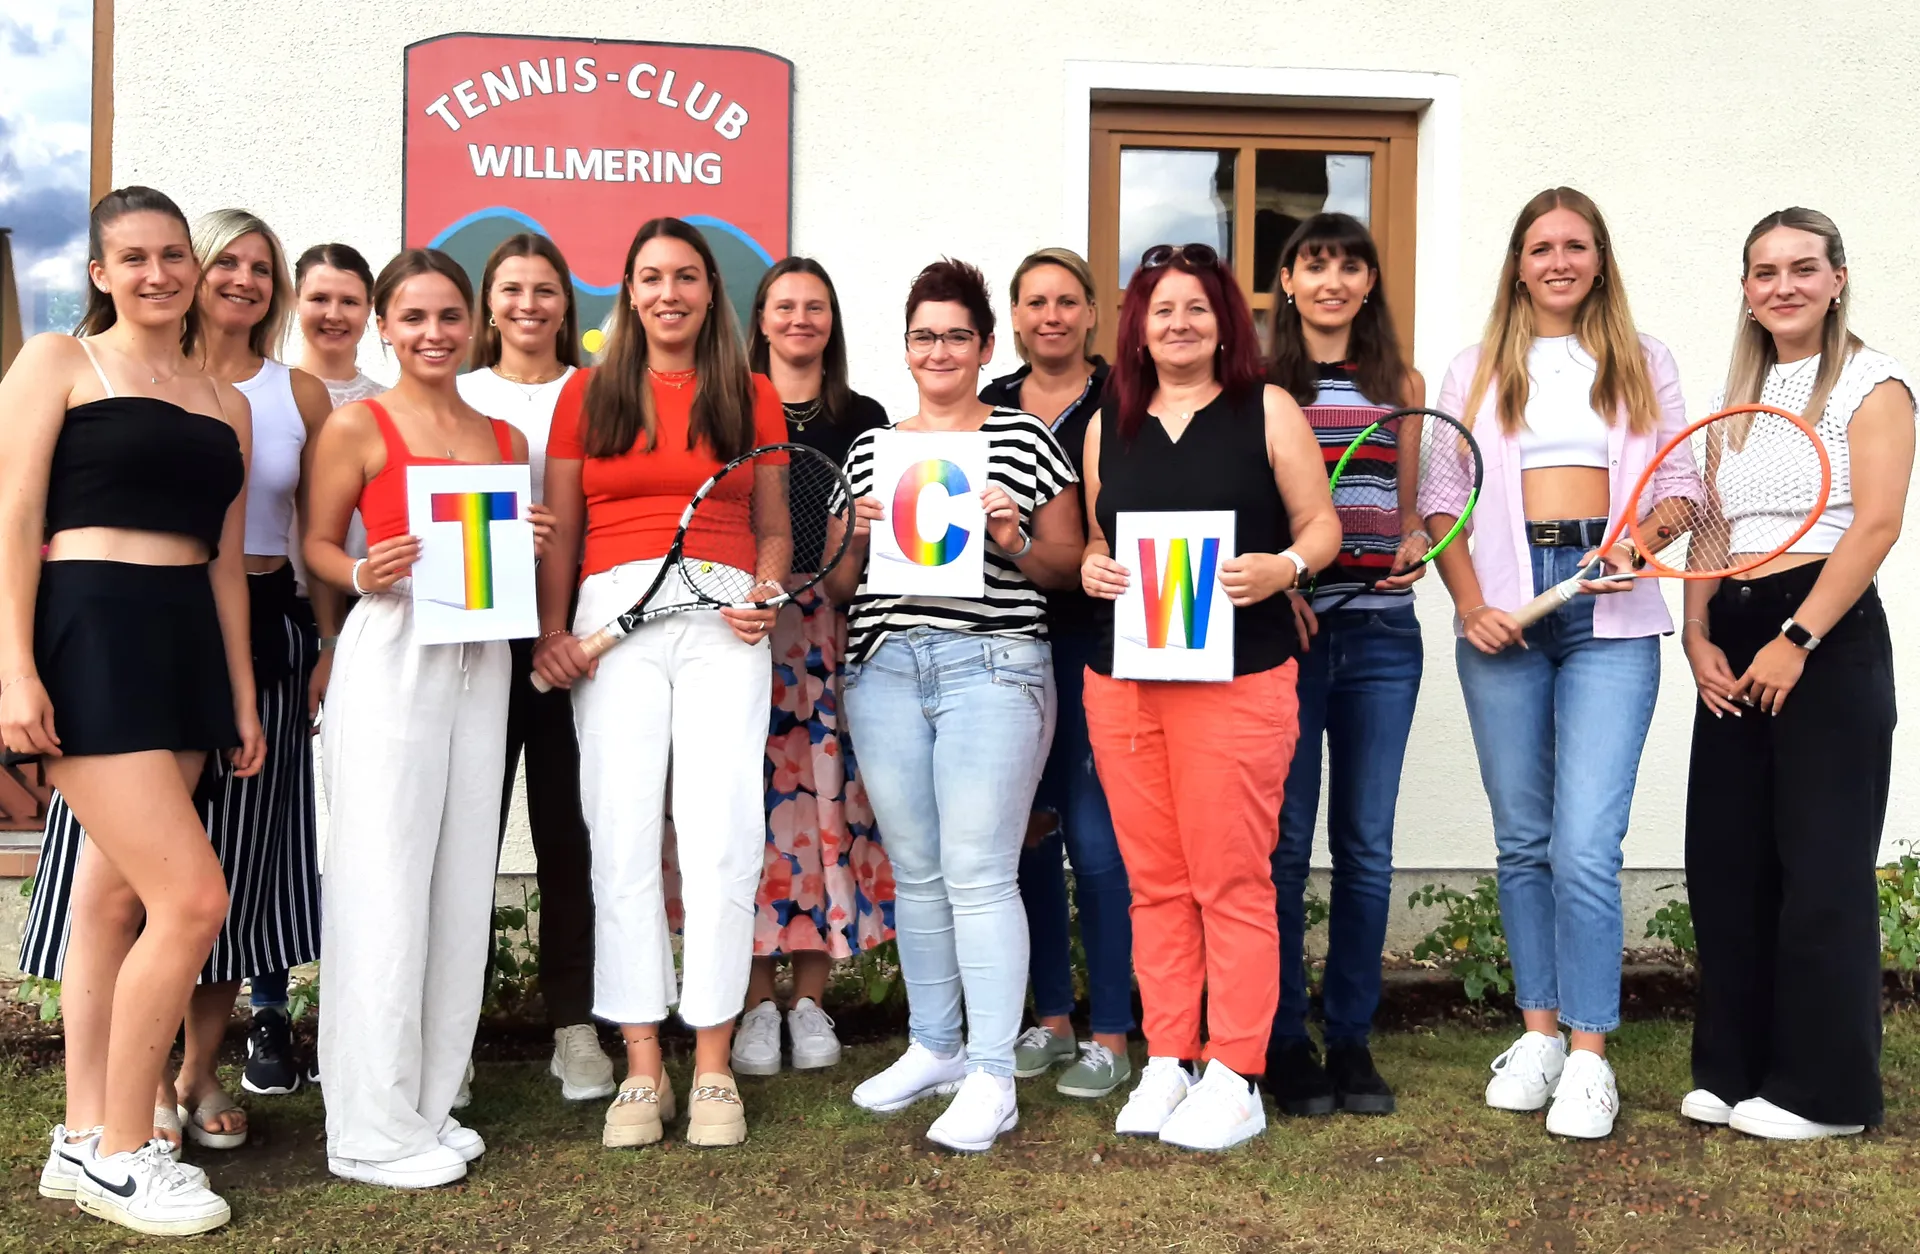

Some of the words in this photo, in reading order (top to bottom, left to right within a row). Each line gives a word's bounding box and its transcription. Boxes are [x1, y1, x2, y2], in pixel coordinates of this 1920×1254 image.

[425, 57, 749, 141] TENNIS-CLUB
[467, 143, 722, 185] WILLMERING
[431, 491, 518, 610] T
[892, 458, 971, 567] C
[1137, 537, 1220, 650] W
